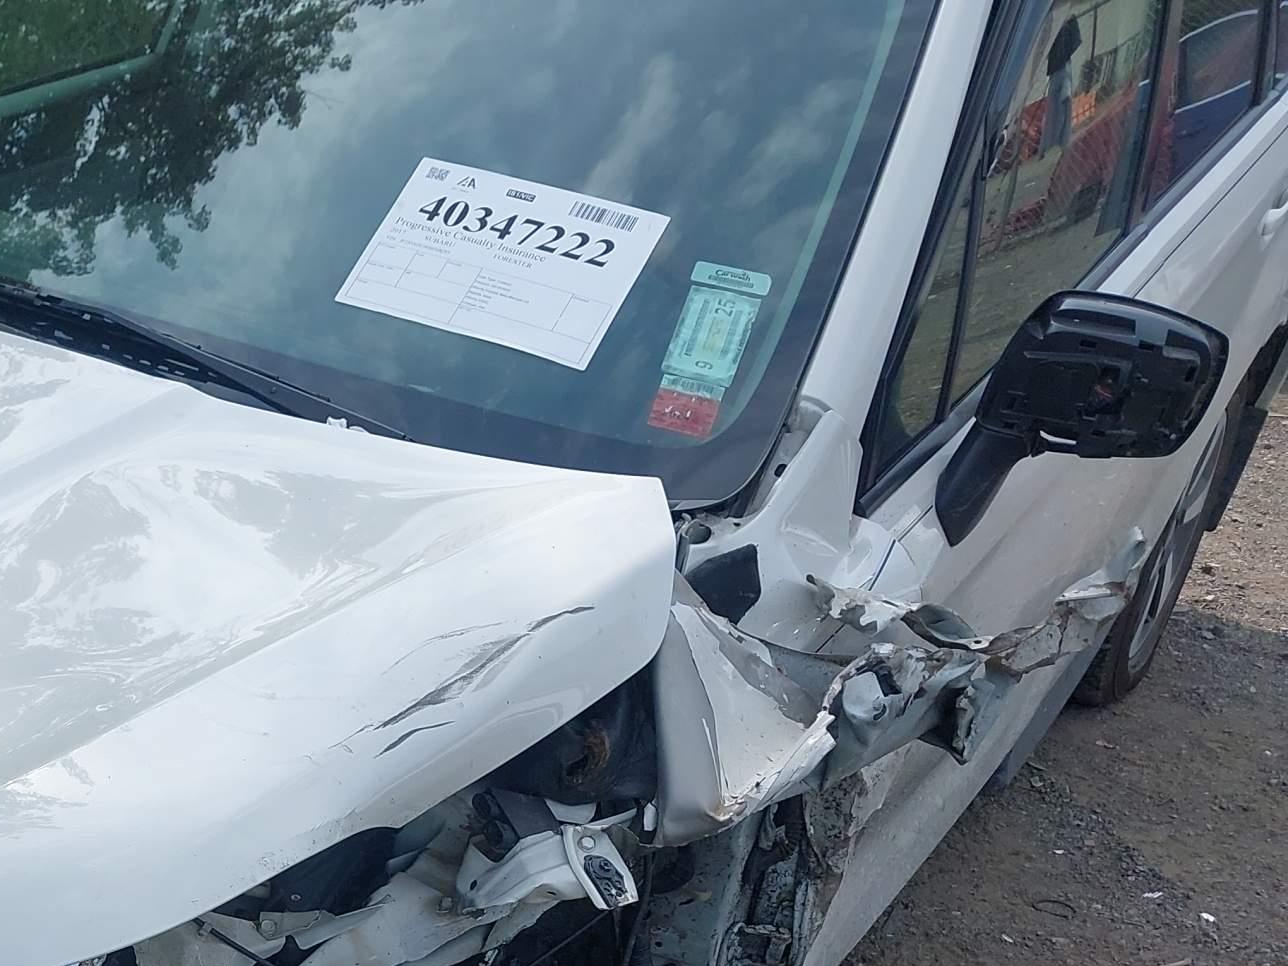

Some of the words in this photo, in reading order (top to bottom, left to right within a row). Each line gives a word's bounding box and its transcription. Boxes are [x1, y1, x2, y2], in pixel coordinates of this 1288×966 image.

[395, 216, 452, 237] Progressive
[453, 230, 496, 250] Casualty
[497, 243, 546, 263] Insurance
[418, 196, 616, 268] 40347222
[425, 235, 456, 248] SUBARU
[714, 298, 736, 317] 25
